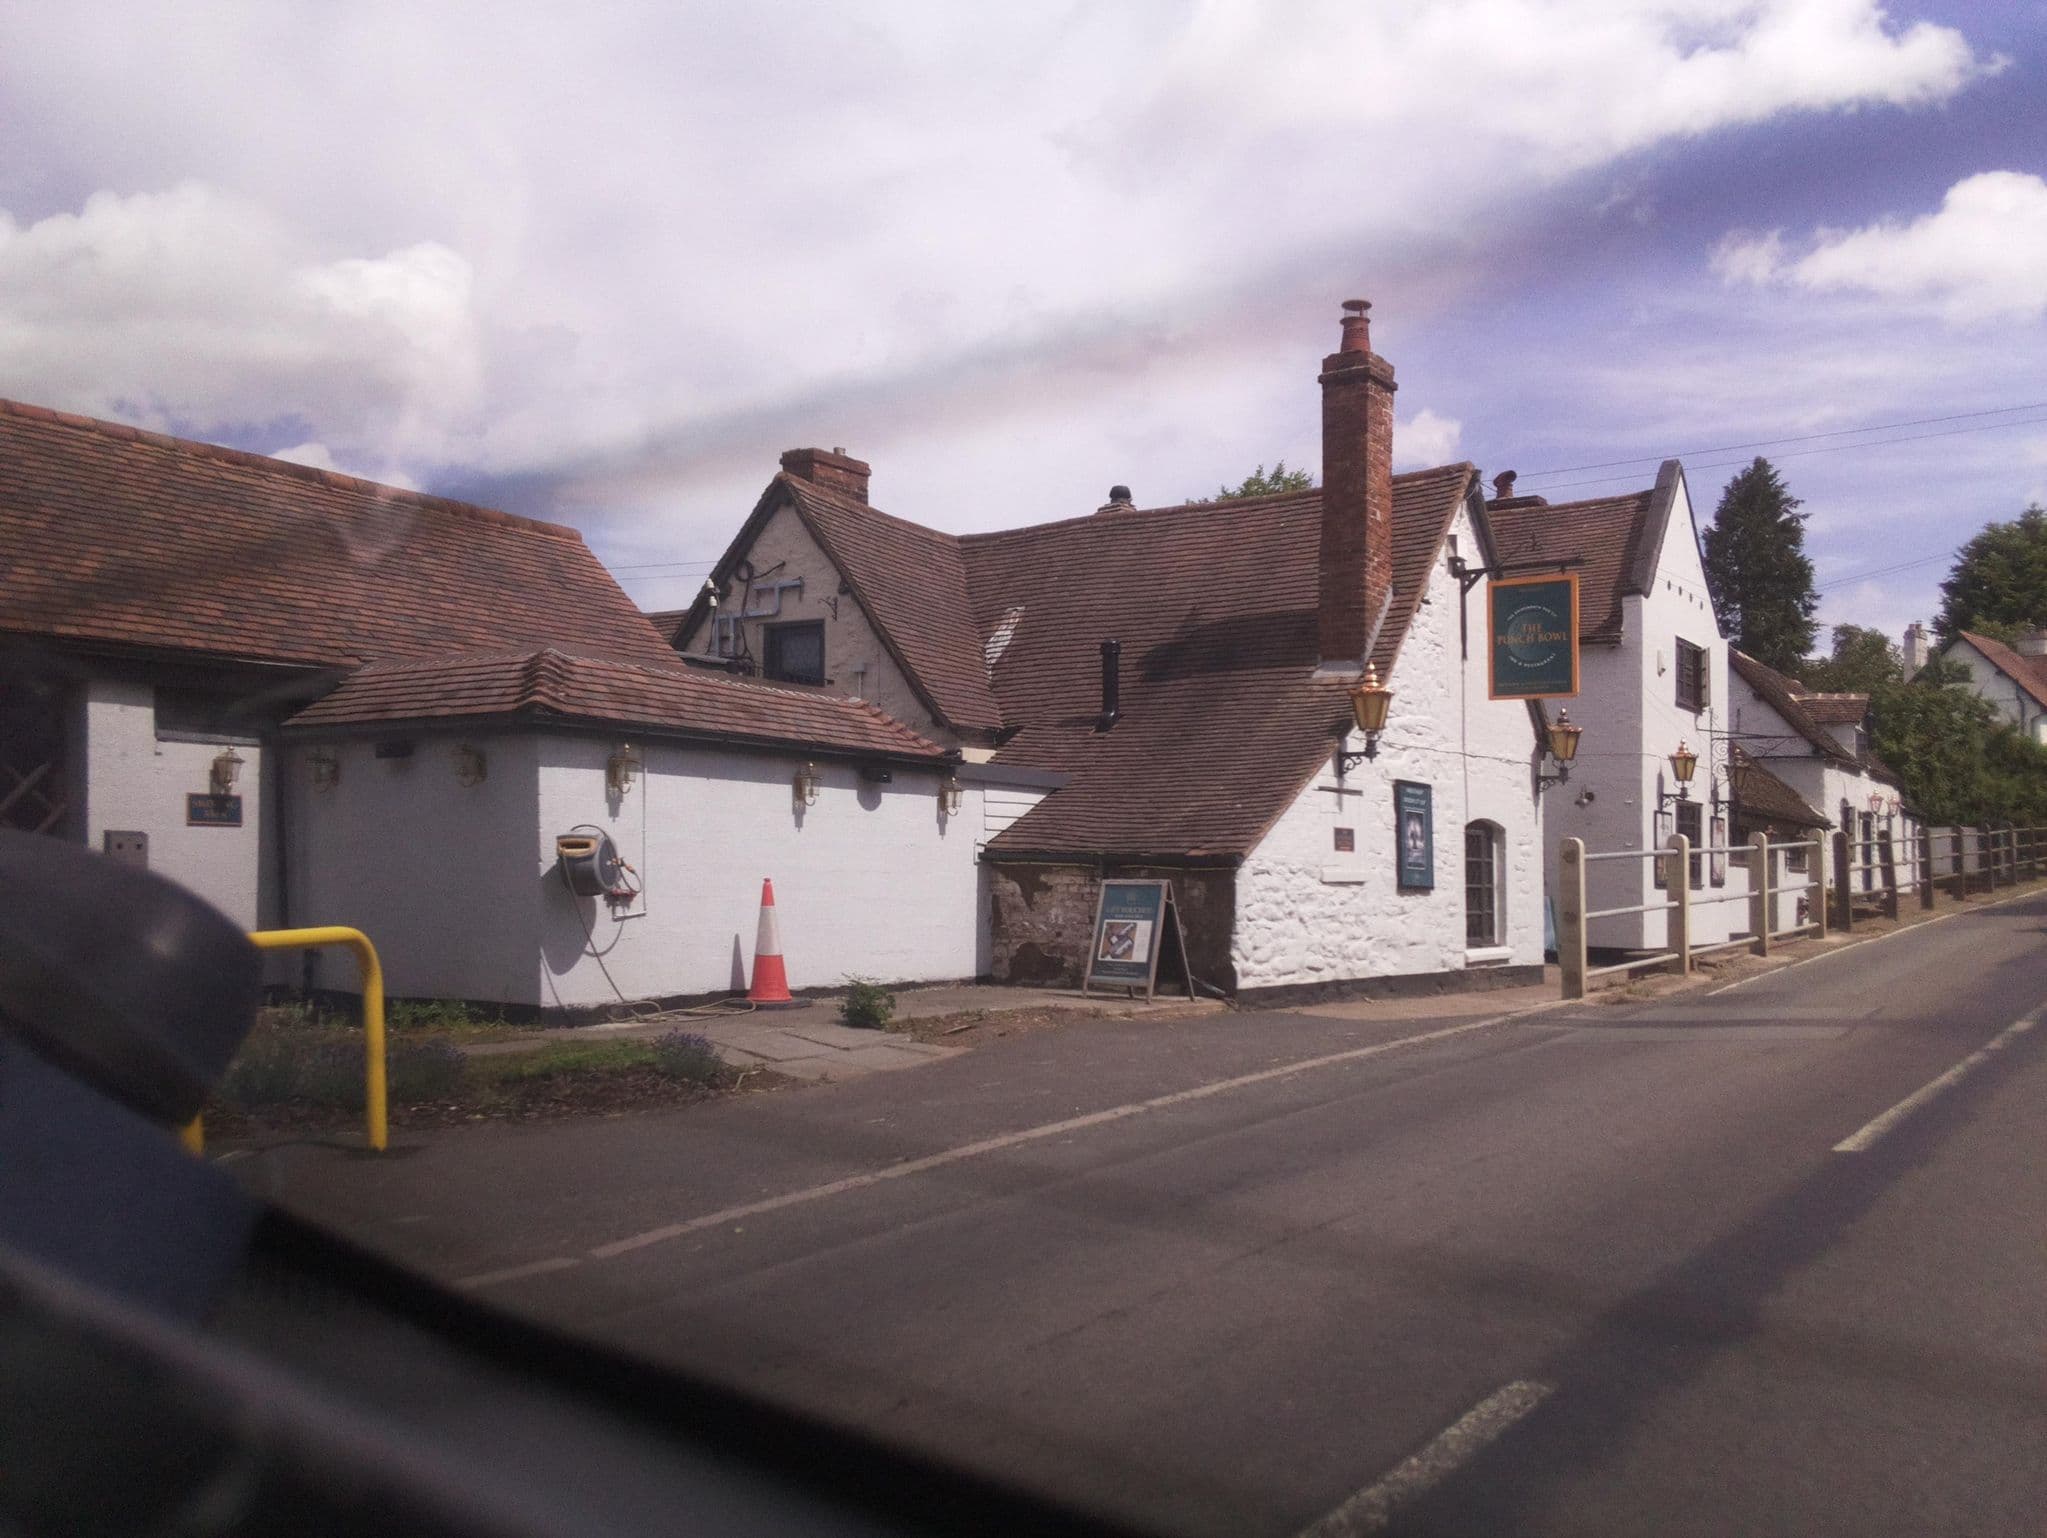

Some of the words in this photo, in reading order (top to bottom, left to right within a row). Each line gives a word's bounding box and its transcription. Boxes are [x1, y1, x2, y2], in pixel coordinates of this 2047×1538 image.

[1521, 623, 1542, 633] THE
[1497, 633, 1535, 646] PUNCH
[1538, 631, 1568, 643] BOWL
